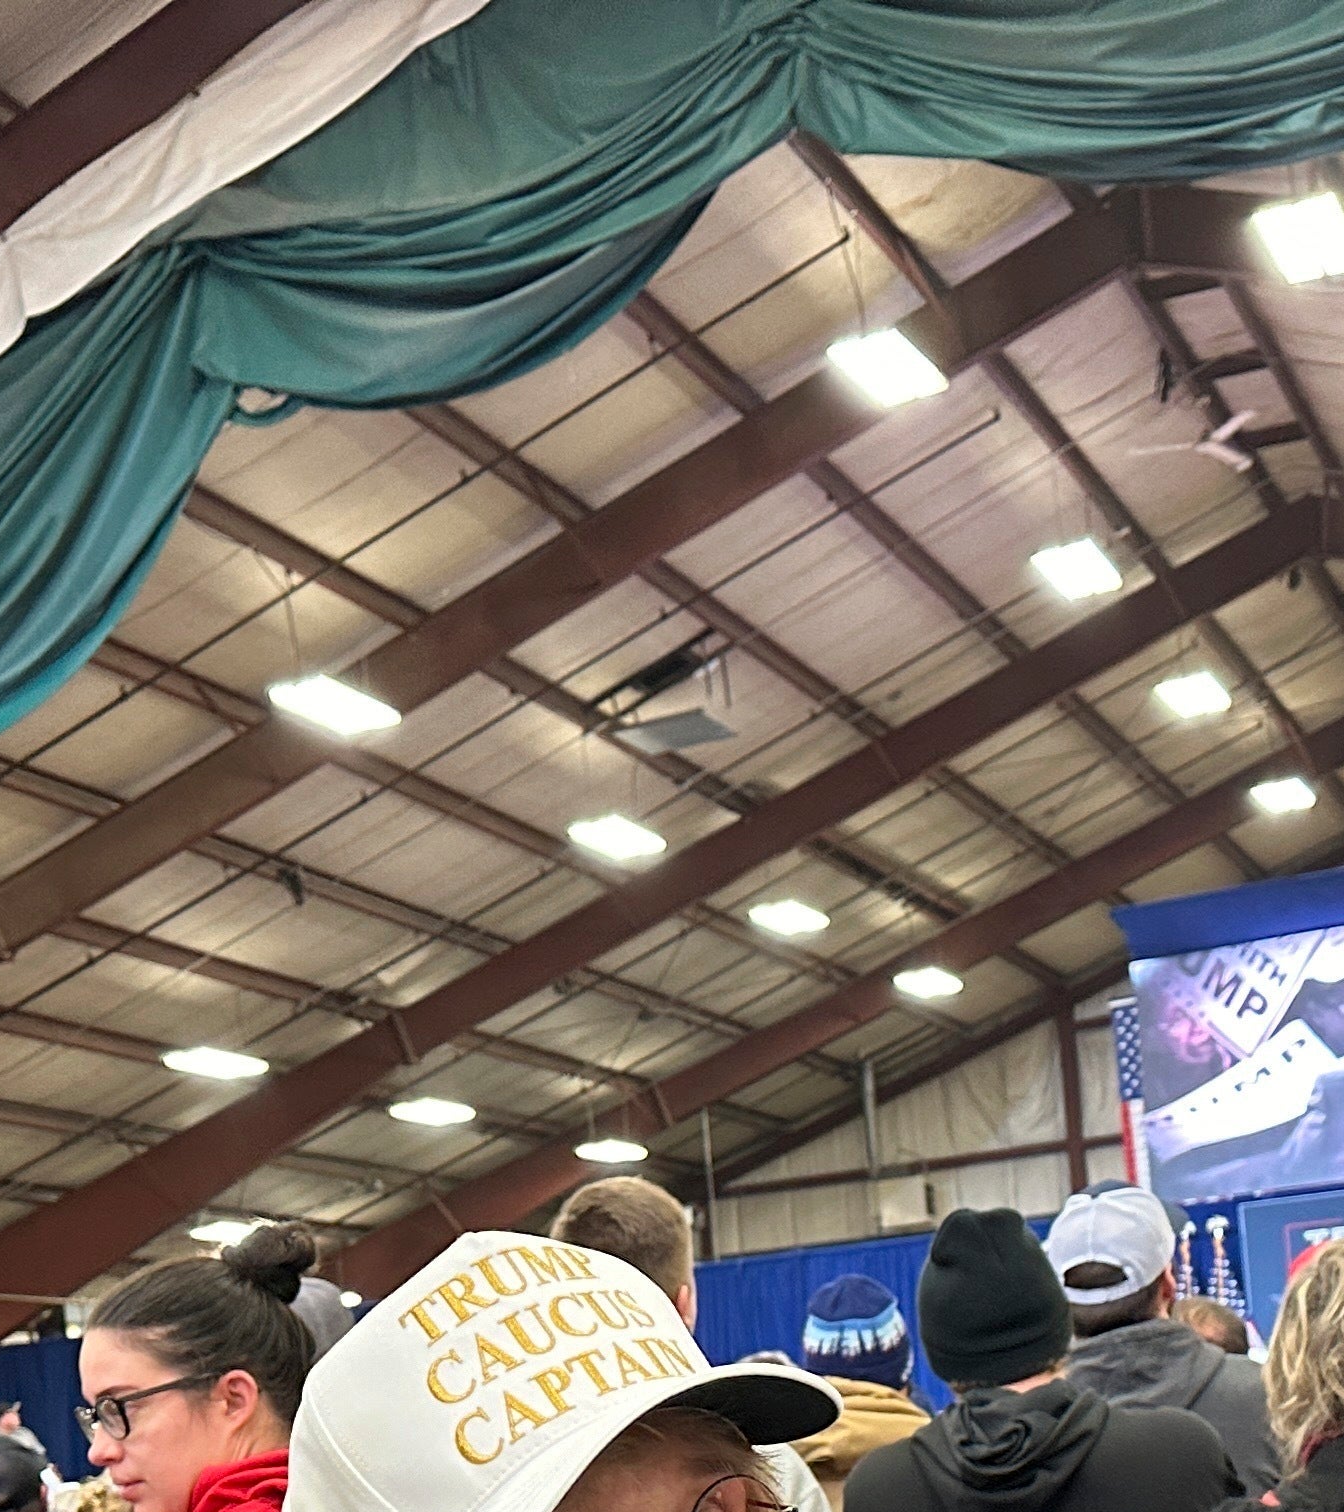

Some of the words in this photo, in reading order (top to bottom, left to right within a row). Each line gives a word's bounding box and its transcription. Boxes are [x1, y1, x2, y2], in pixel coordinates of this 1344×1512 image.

[398, 1245, 599, 1347] TRUMP
[426, 1289, 656, 1404] CAUCUS
[454, 1336, 697, 1466] CAPTAIN
